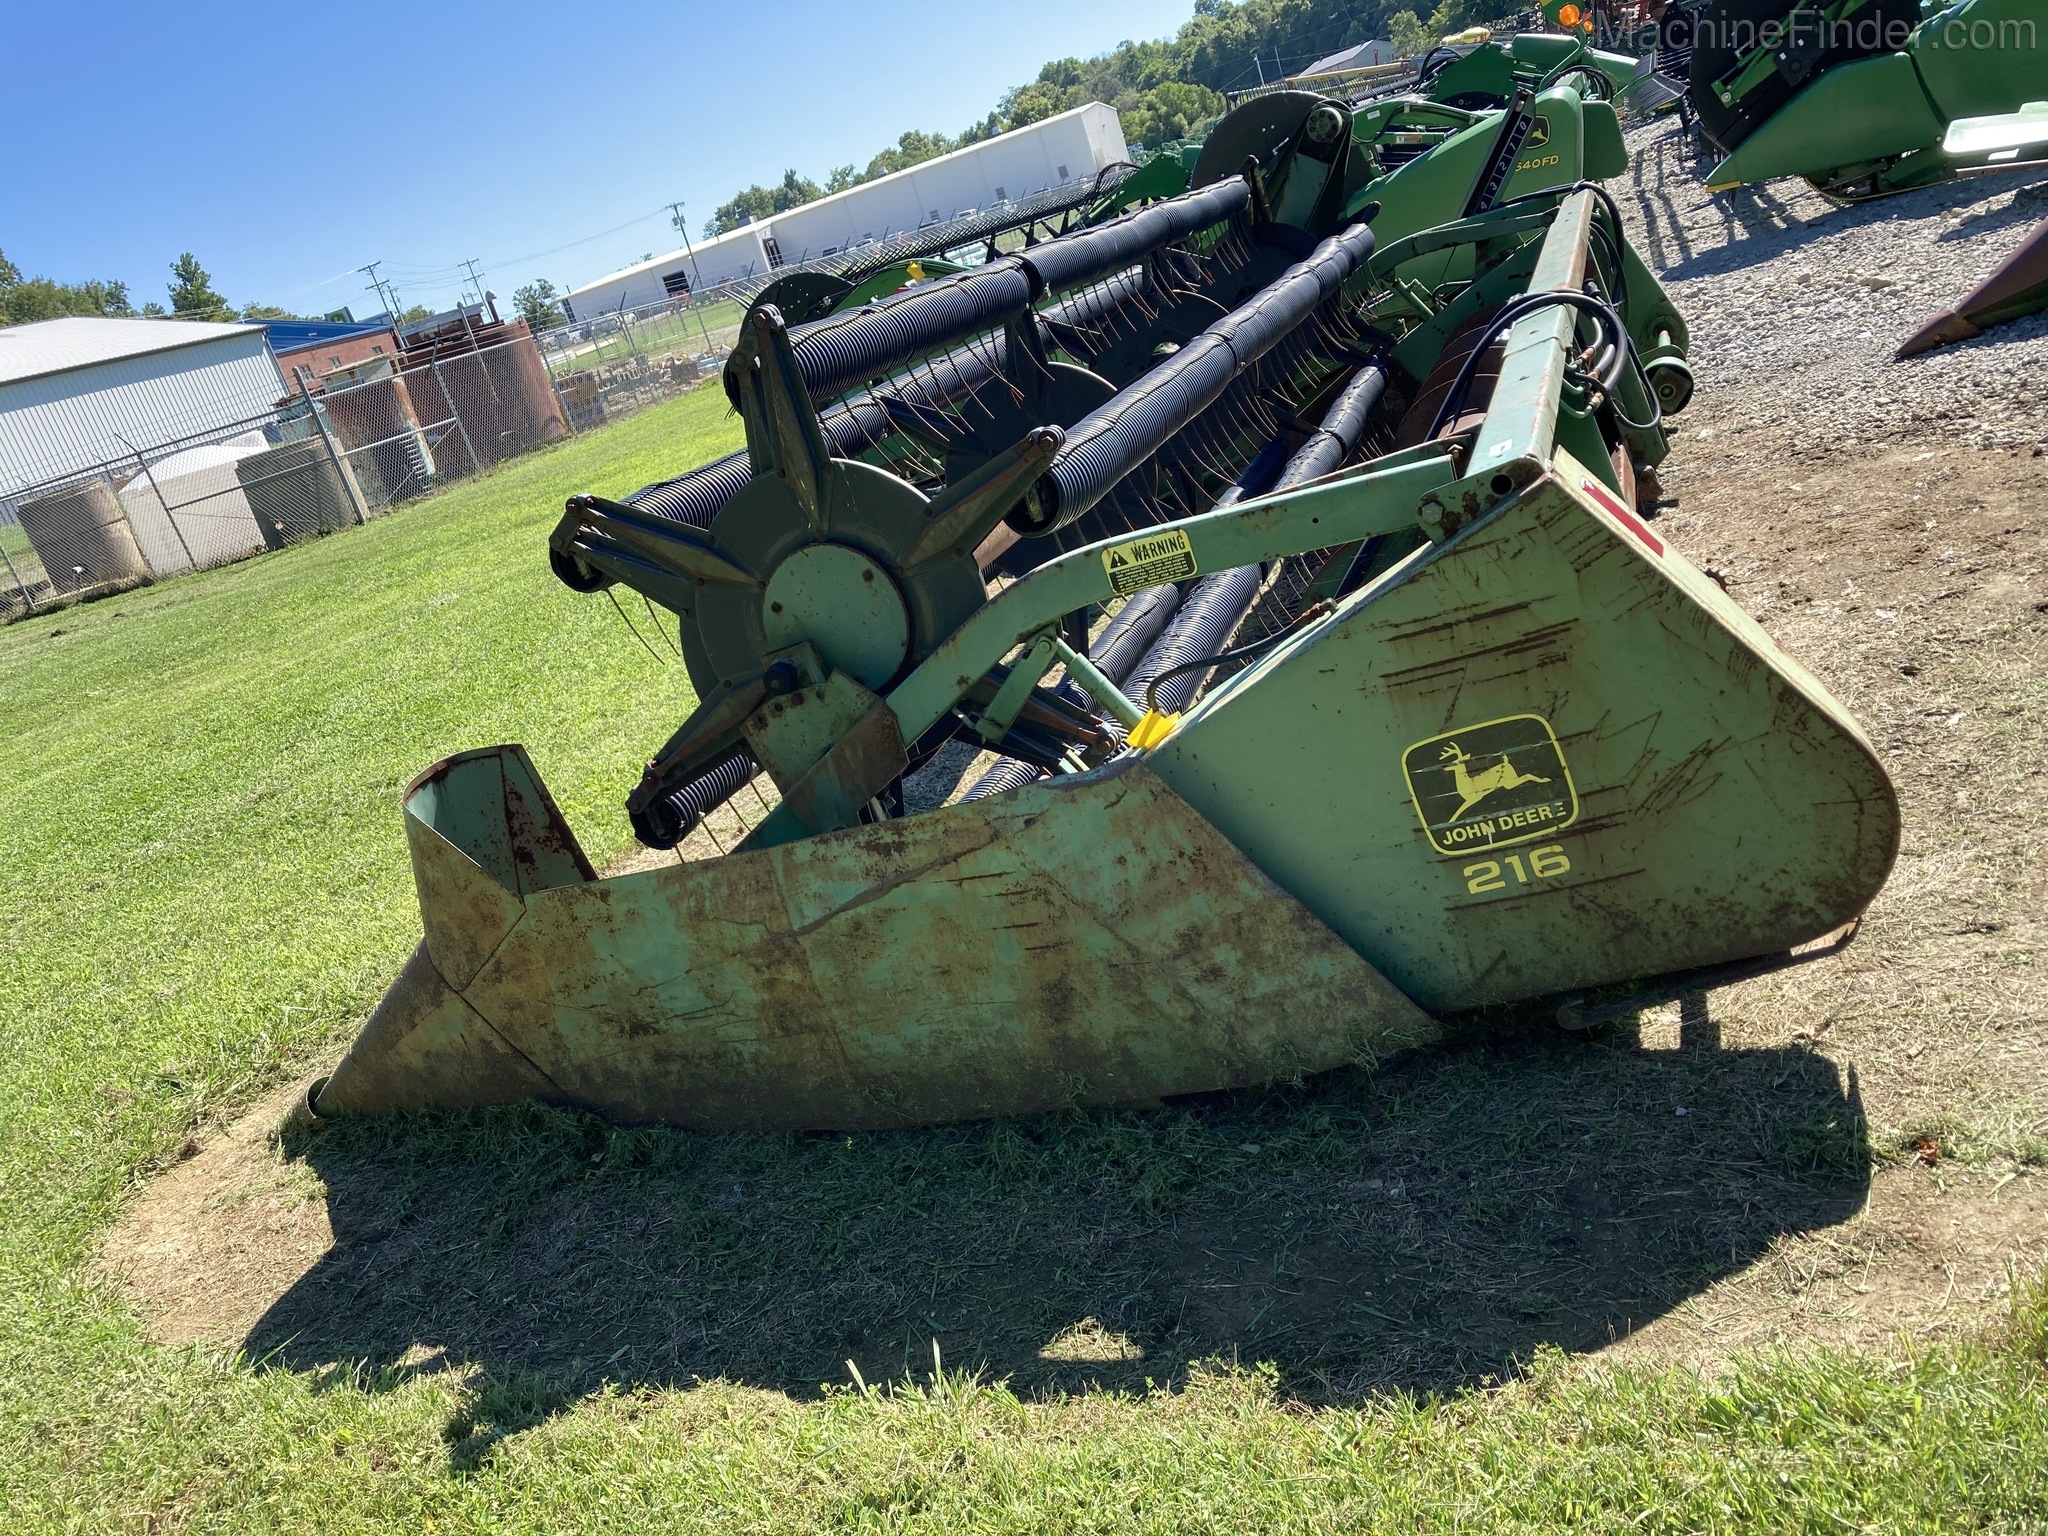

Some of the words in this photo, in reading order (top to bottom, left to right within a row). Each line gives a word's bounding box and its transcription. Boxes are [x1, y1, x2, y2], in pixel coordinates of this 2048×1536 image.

[1489, 181, 1498, 191] 3
[1499, 161, 1508, 171] 2
[1509, 142, 1516, 151] 1
[1519, 121, 1527, 131] 0
[1131, 535, 1186, 563] WARNING
[1442, 820, 1496, 845] JOHN
[1463, 844, 1571, 895] 216
